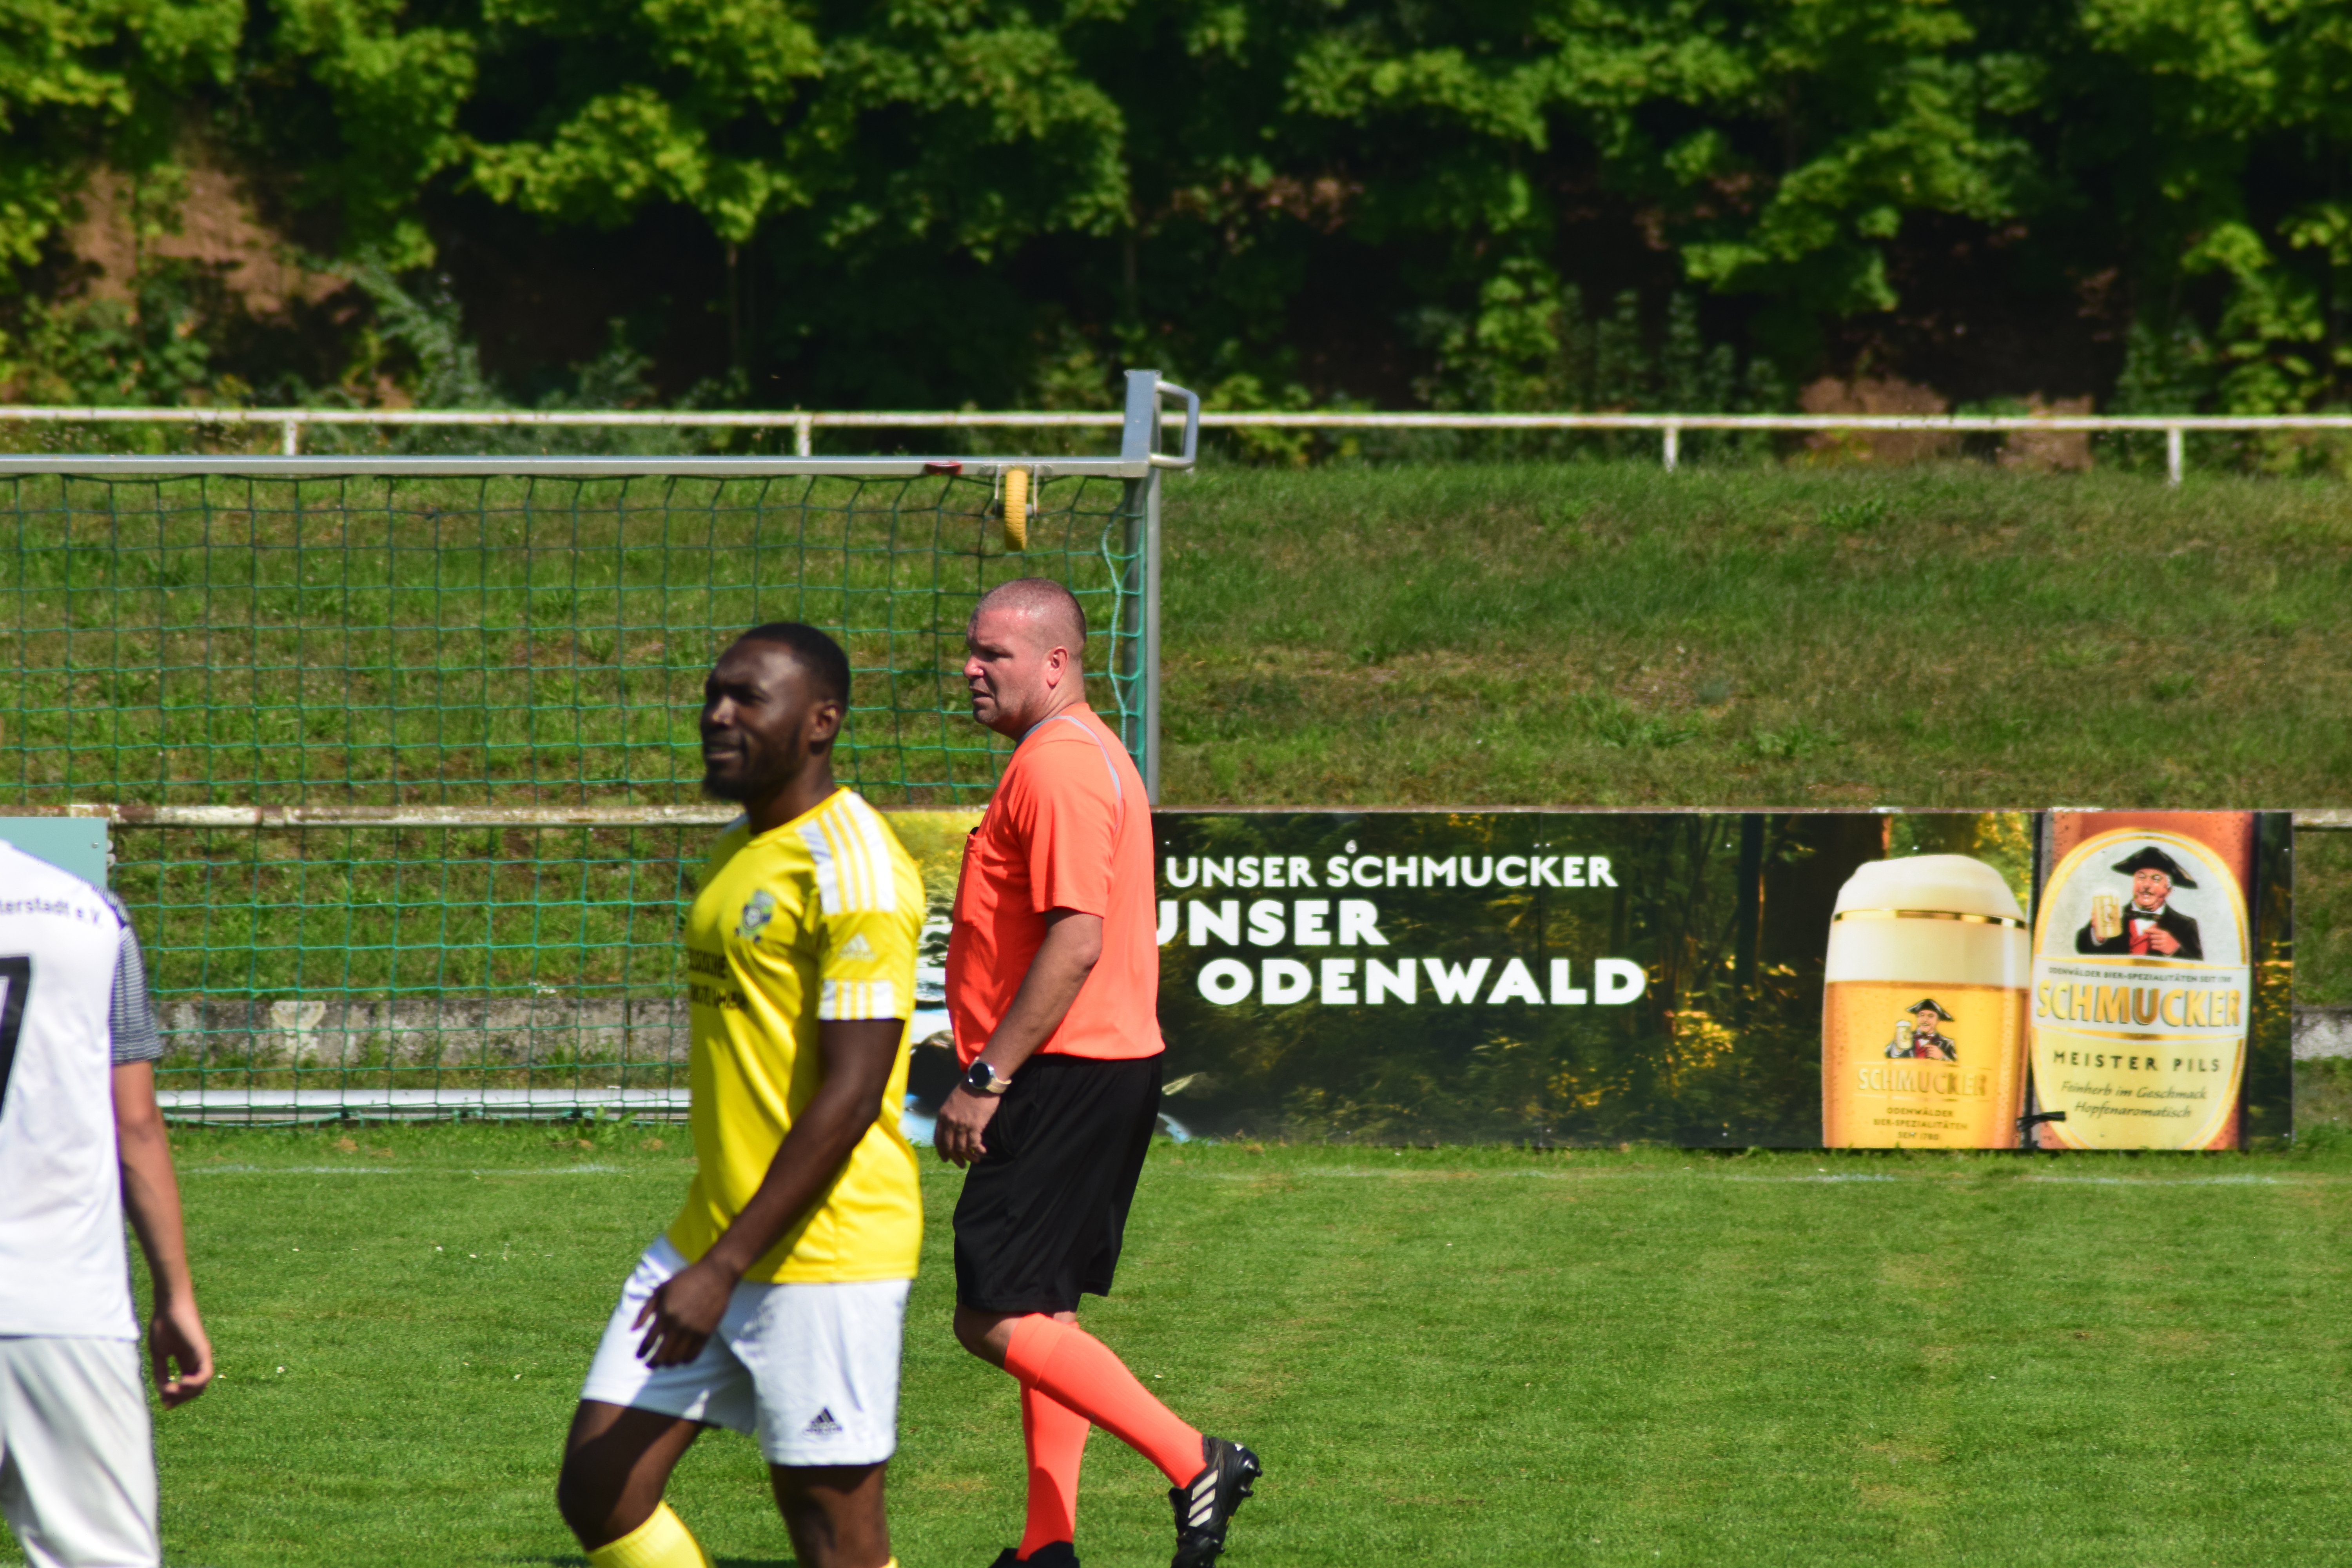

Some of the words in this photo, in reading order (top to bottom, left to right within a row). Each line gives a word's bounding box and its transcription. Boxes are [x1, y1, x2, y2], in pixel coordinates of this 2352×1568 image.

[1166, 856, 1318, 888] UNSER
[1327, 855, 1619, 887] SCHMUCKER
[1197, 958, 1646, 1005] ODENWALD
[2037, 980, 2241, 1026] SCHMUCKER
[2053, 1051, 2159, 1071] MEISTER
[2172, 1058, 2220, 1072] PILS
[1858, 1068, 1987, 1096] SCHMUCKER
[2061, 1081, 2112, 1096] Feinherb
[2116, 1085, 2132, 1098] im
[2136, 1085, 2207, 1099] Geschmack
[1886, 1107, 1954, 1117] ODENWÄLDER
[2074, 1101, 2191, 1119] Hopfenaromatisch
[1873, 1118, 1967, 1130] BIER-SPEZIALITÄTEN
